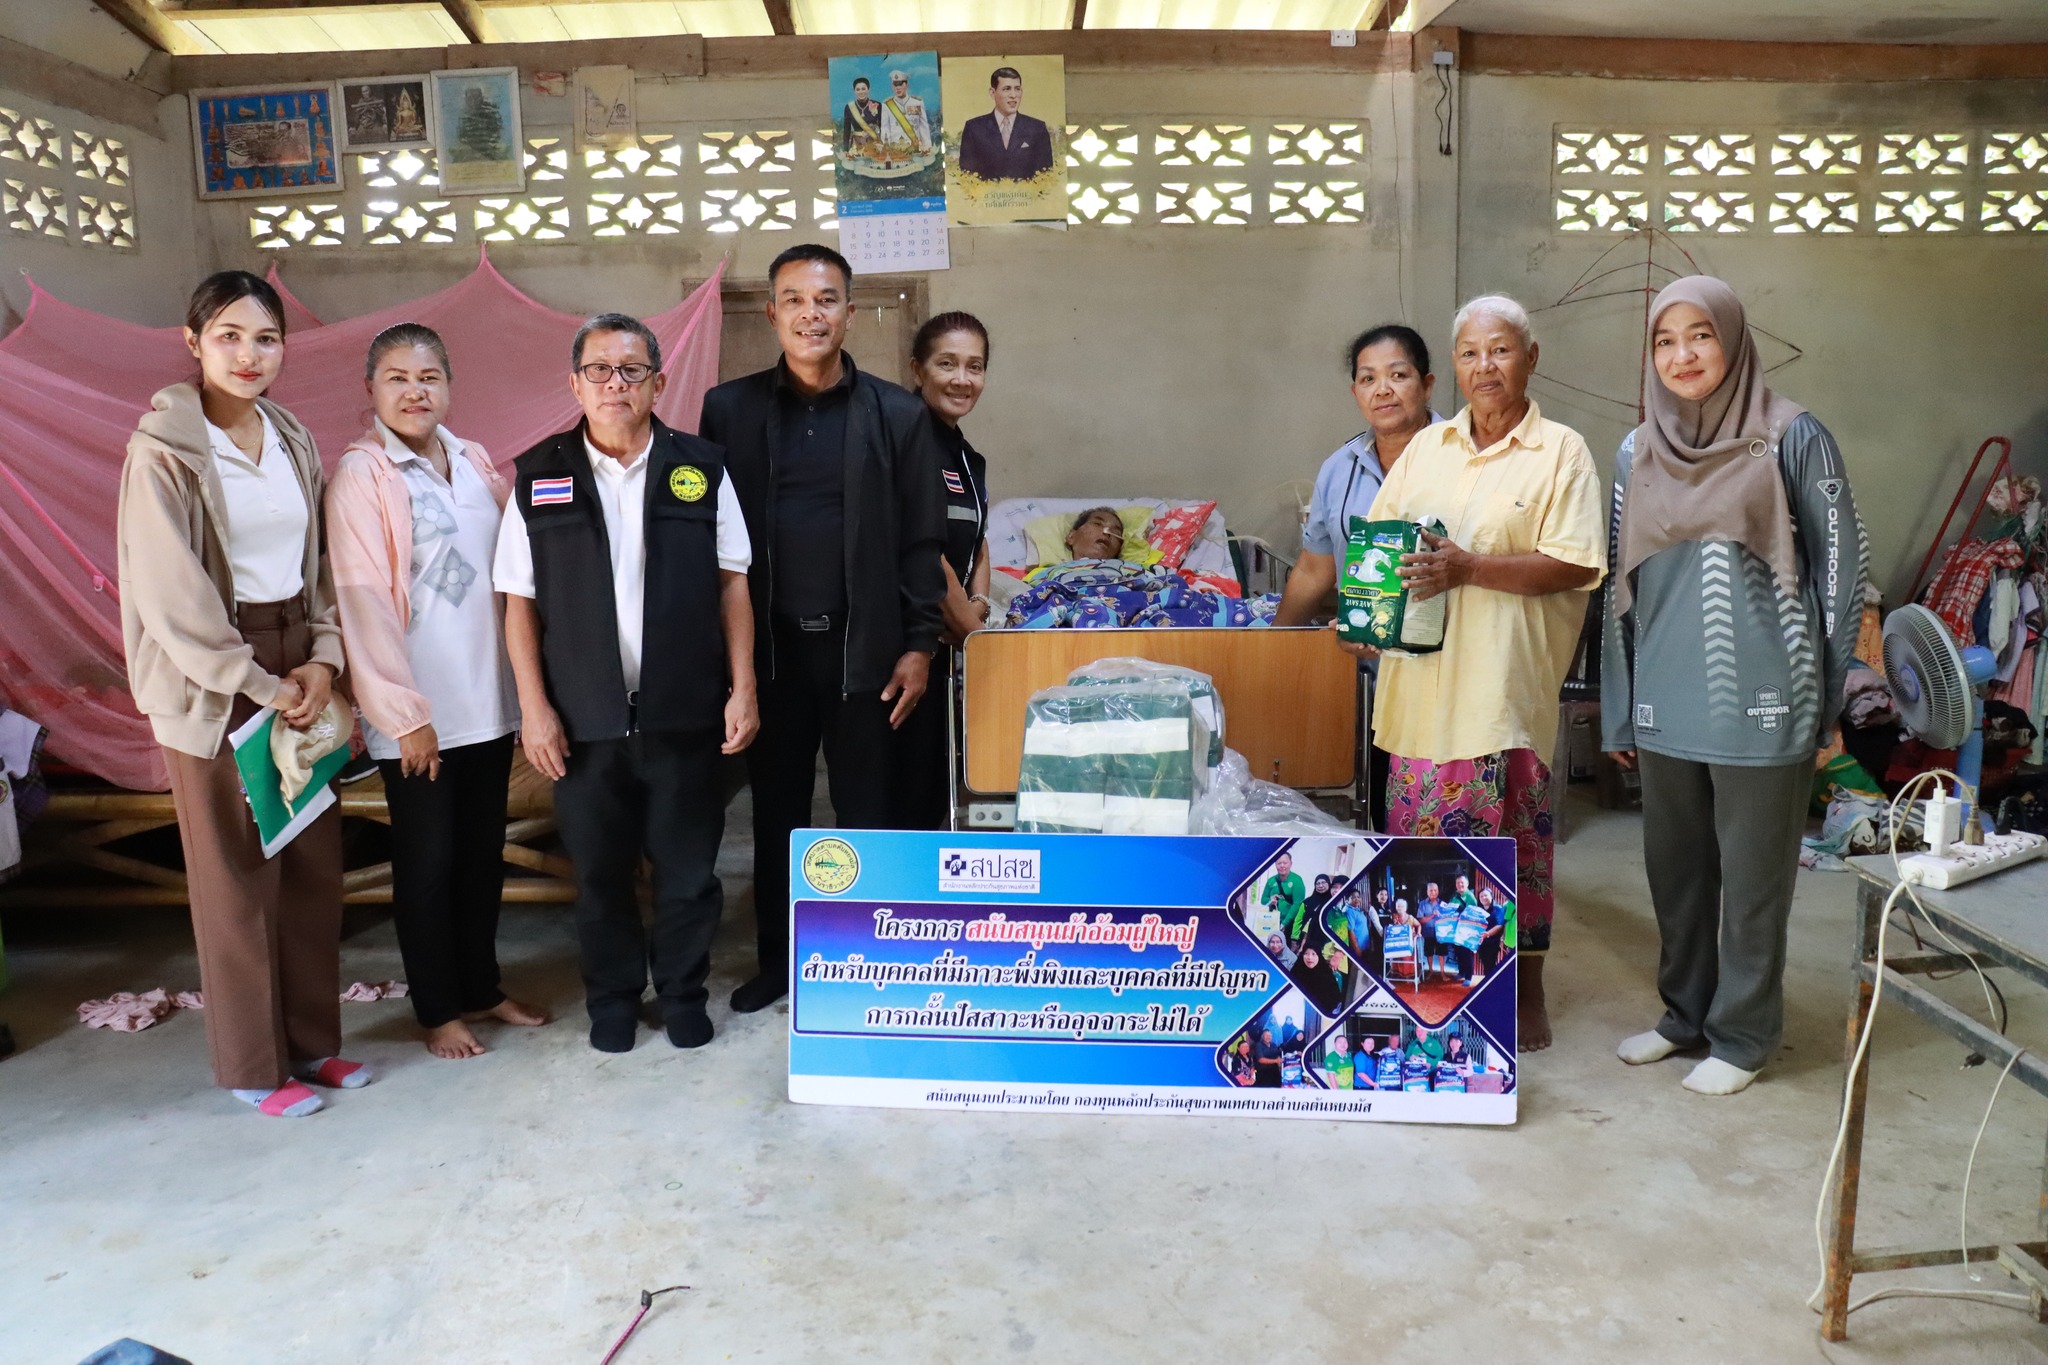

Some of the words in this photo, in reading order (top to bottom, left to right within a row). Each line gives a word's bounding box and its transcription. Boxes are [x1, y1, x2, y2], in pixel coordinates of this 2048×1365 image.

[842, 206, 847, 214] 2
[971, 854, 1035, 879] สปสช.
[875, 910, 963, 938] โครงการ
[968, 914, 1197, 950] สนับสนุนผ้าอ้อมผู้ใหญ่
[804, 952, 1267, 995] สำหรับบุคคลที่มีภาวะพึ่งพิงและบุคคลที่มีปัญหา
[867, 994, 1210, 1037] การกลั้นปัสสาวะหรืออุจจาระไม่ได้
[926, 1088, 1070, 1107] สนับสนุนงบประมาณโดย
[1074, 1092, 1373, 1113] กองทุนหลักประกันสุขภาพเทศบาลตำบลตันหยงมัส
